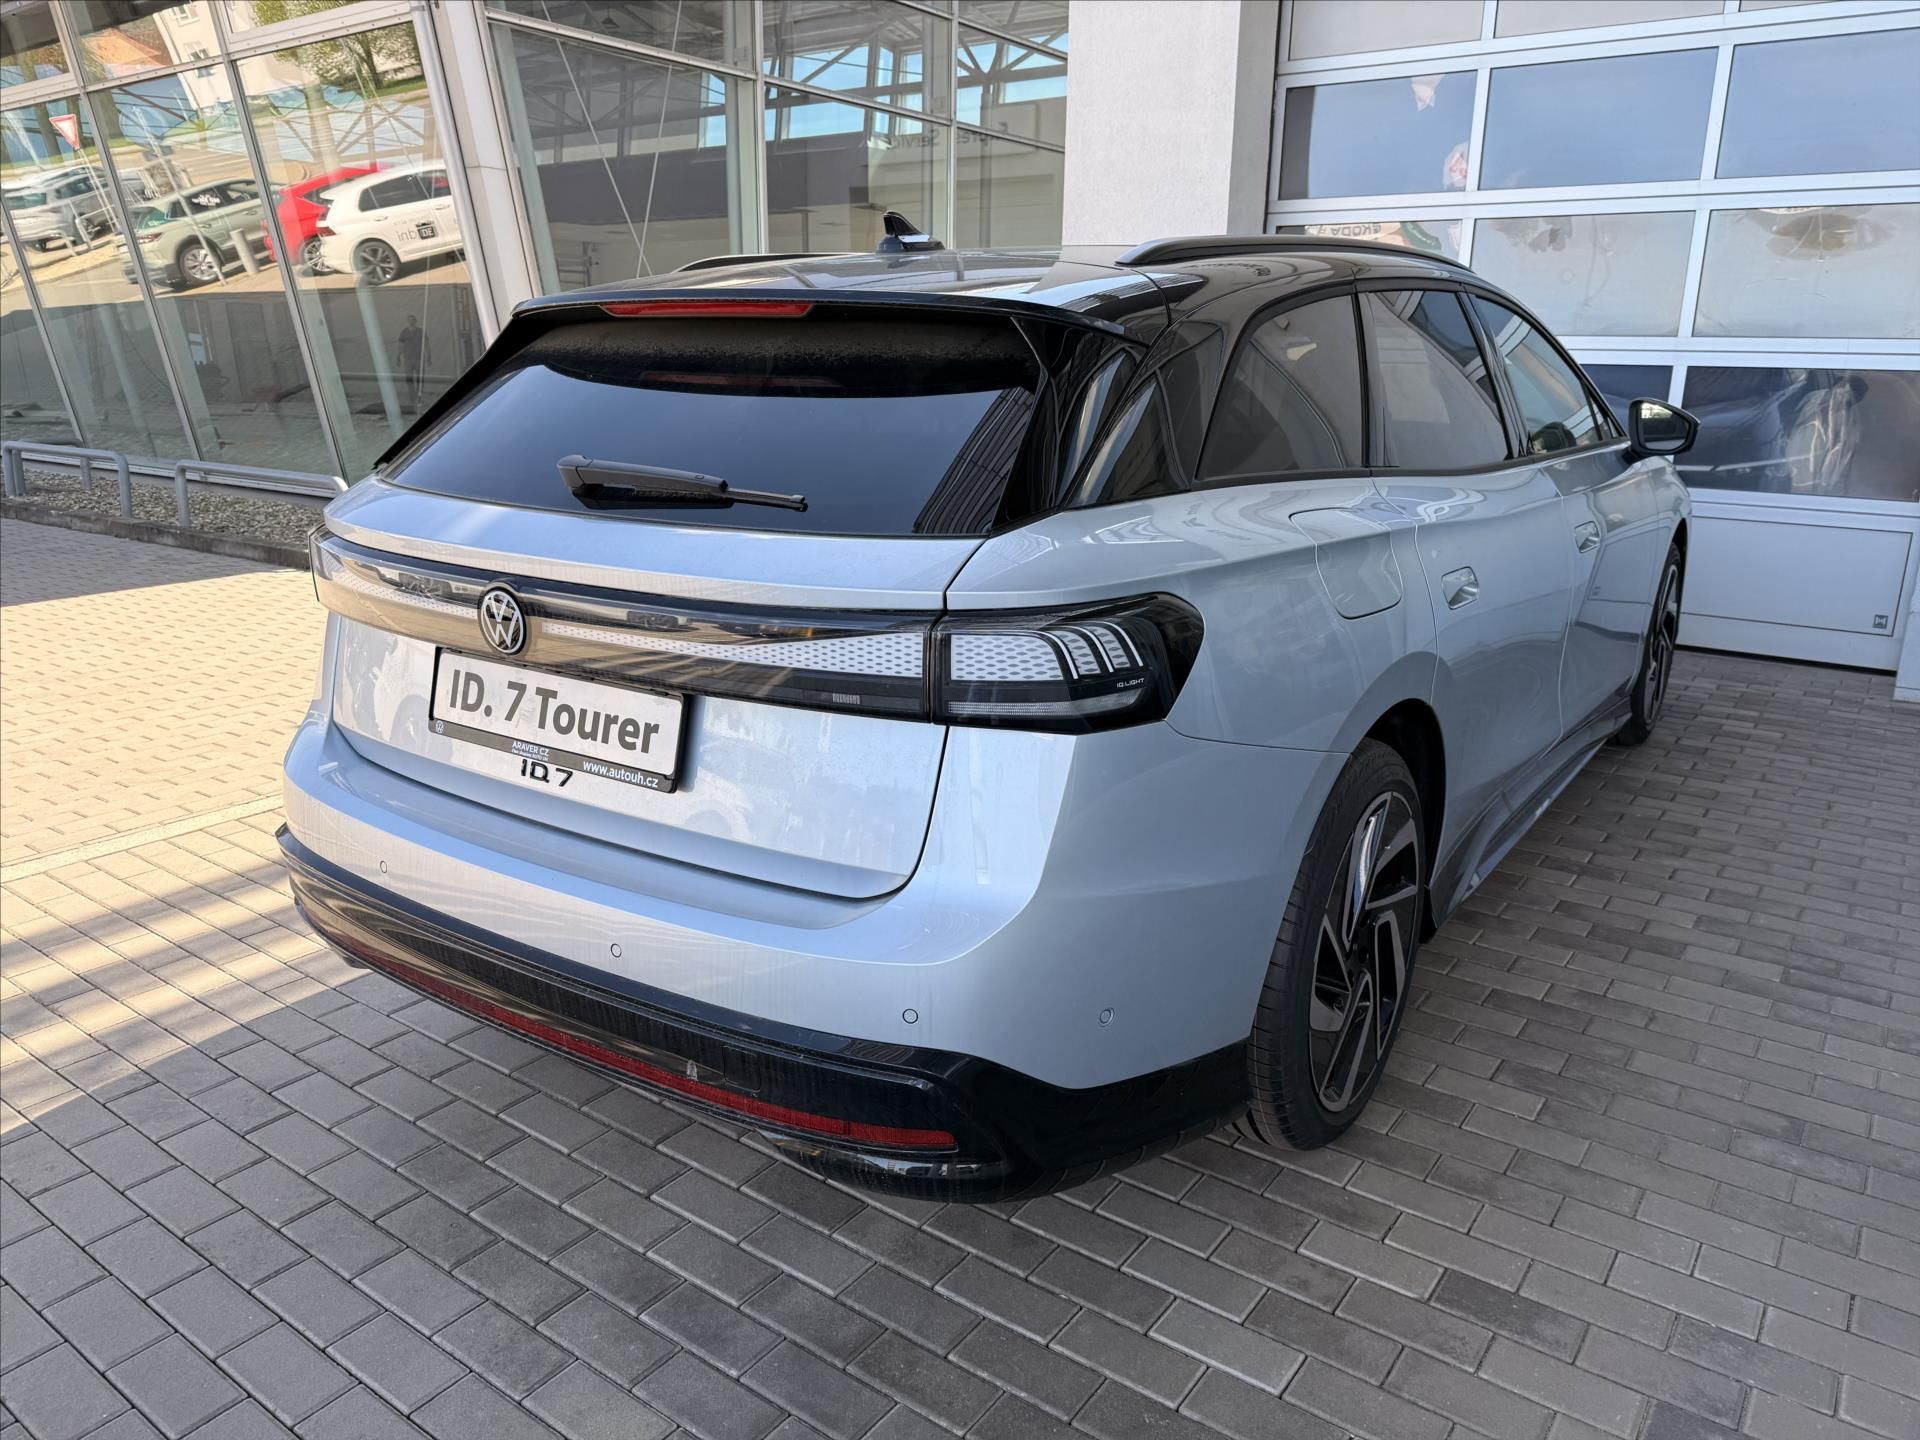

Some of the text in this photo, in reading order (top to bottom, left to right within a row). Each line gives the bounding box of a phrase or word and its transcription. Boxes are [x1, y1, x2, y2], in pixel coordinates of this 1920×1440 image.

[449, 669, 660, 754] ID. 7 Tourer
[511, 740, 539, 754] ARAVER
[583, 761, 659, 788] www.autouh.cz
